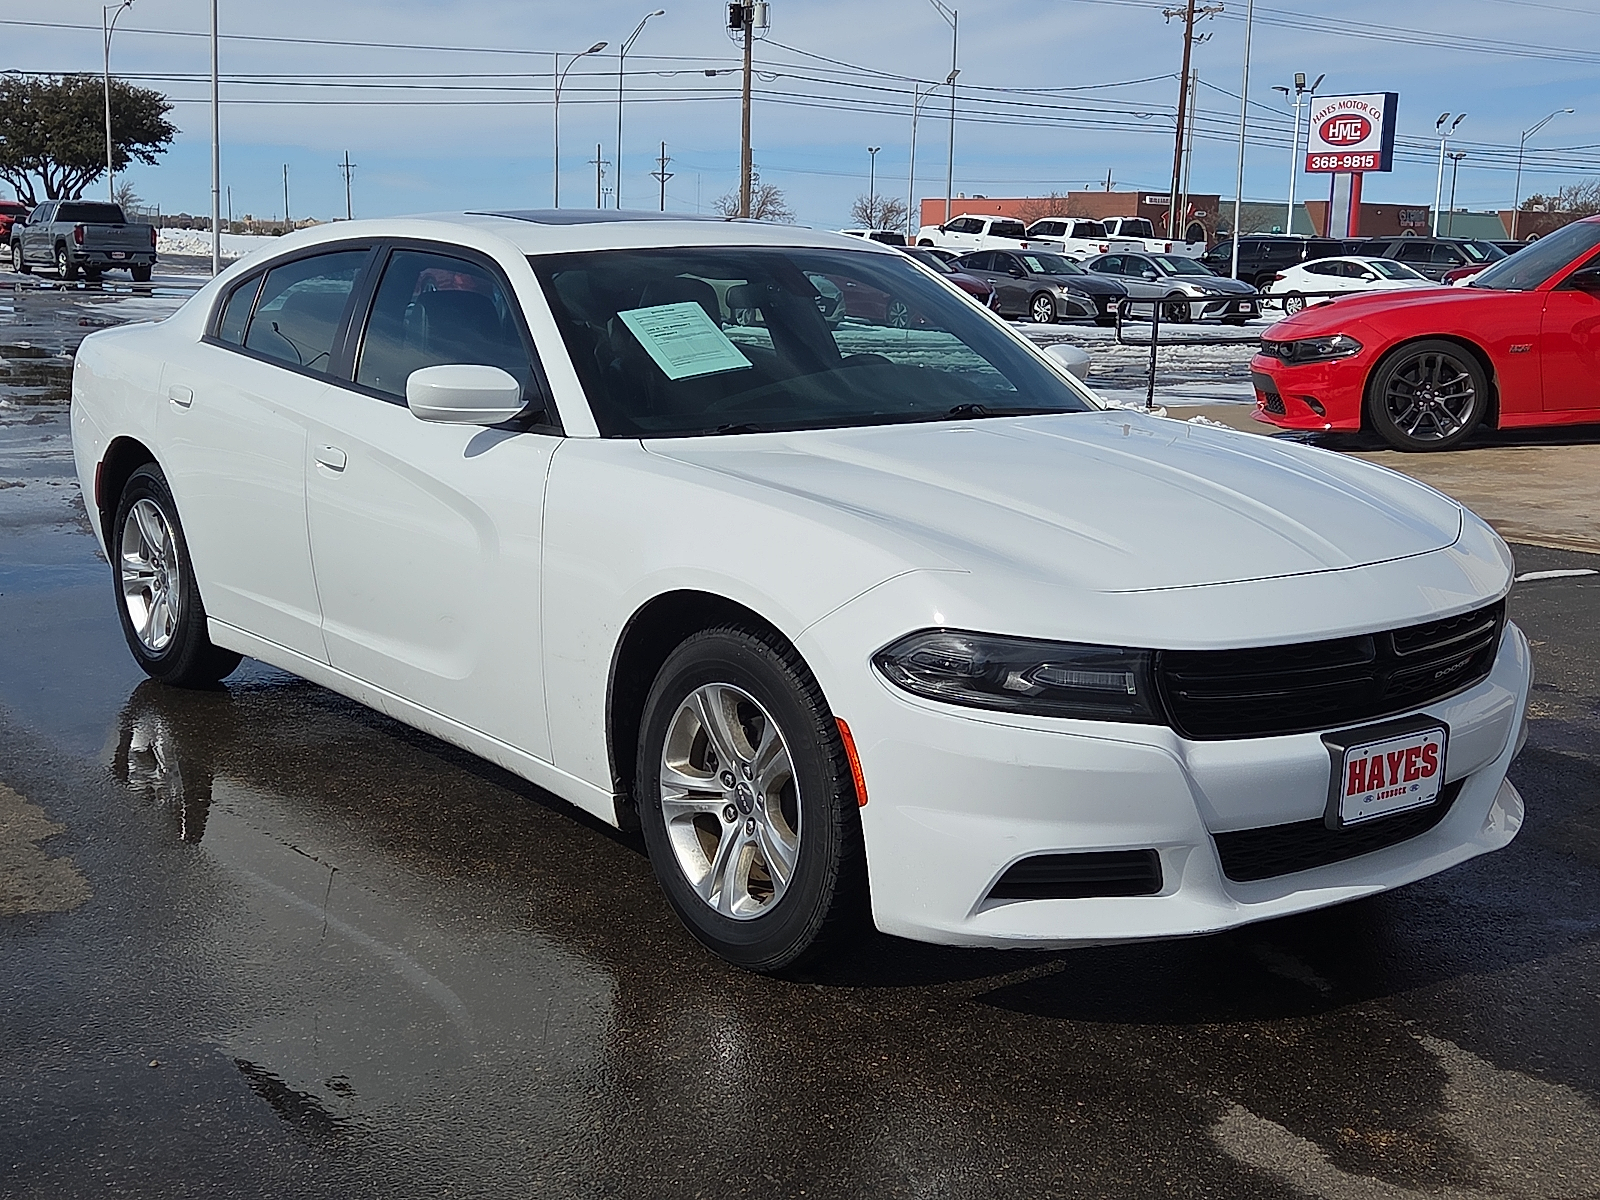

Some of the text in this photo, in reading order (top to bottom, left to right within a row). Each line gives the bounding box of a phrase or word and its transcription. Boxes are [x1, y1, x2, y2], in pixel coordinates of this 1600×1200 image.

[1312, 100, 1381, 124] HAYES MOTOR CO.
[1328, 119, 1362, 141] HMC
[1312, 155, 1374, 168] 368-9815
[1347, 743, 1439, 796] HAYES
